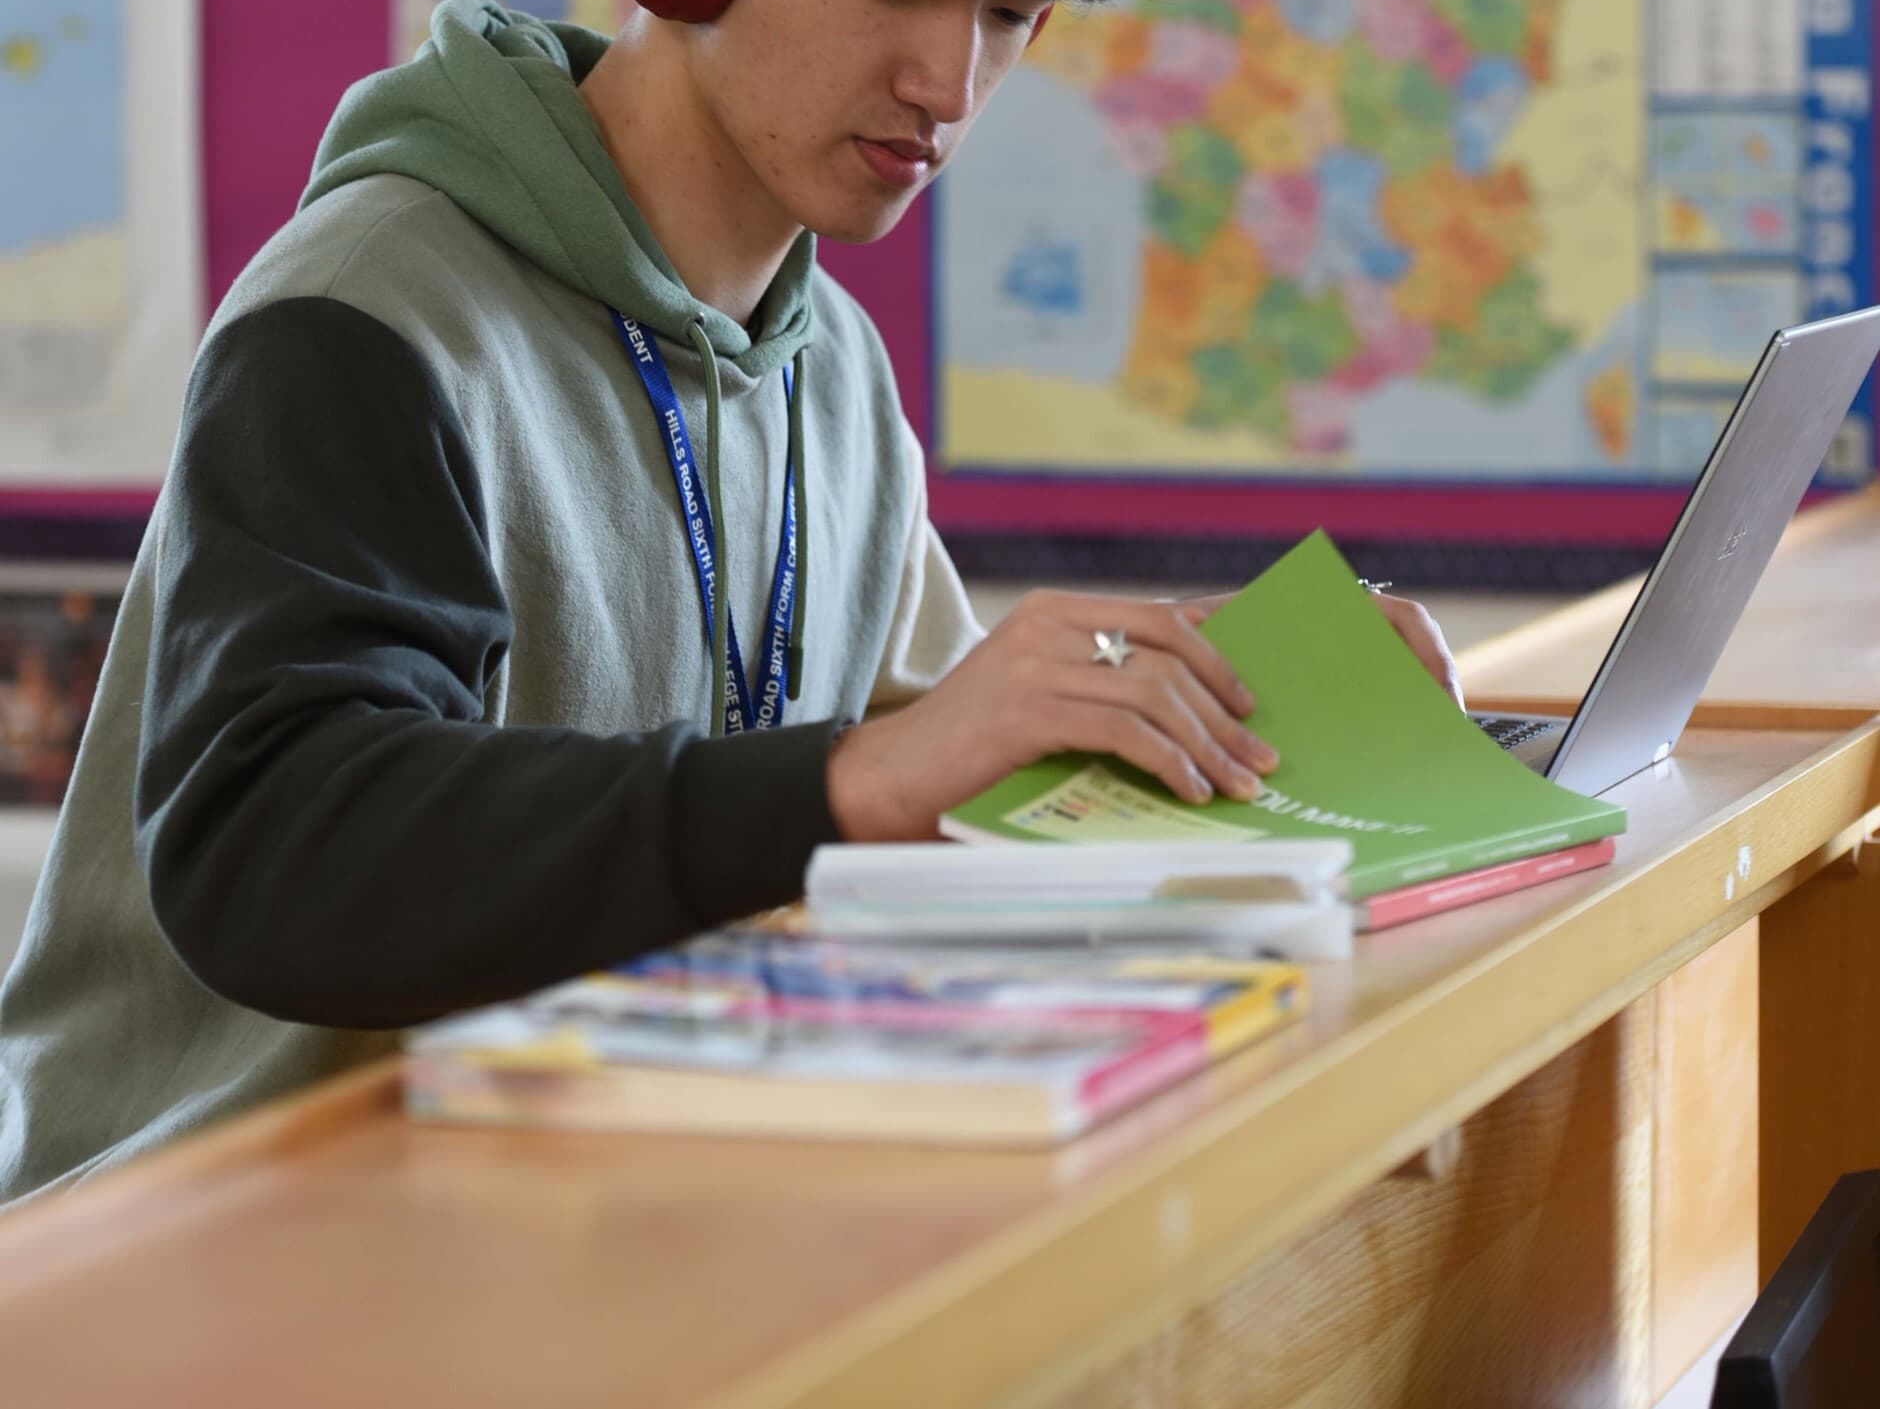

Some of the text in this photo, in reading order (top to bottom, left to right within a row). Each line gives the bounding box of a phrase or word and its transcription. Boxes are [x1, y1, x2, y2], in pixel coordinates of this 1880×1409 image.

[1805, 67, 1870, 320] Franc
[620, 312, 653, 363] DENT
[665, 409, 685, 461] HILLS
[679, 466, 698, 515] ROAD
[692, 518, 712, 569] SIXTH
[775, 570, 794, 623] FORM
[769, 626, 785, 676] SIXTH
[756, 680, 780, 731] ROAD
